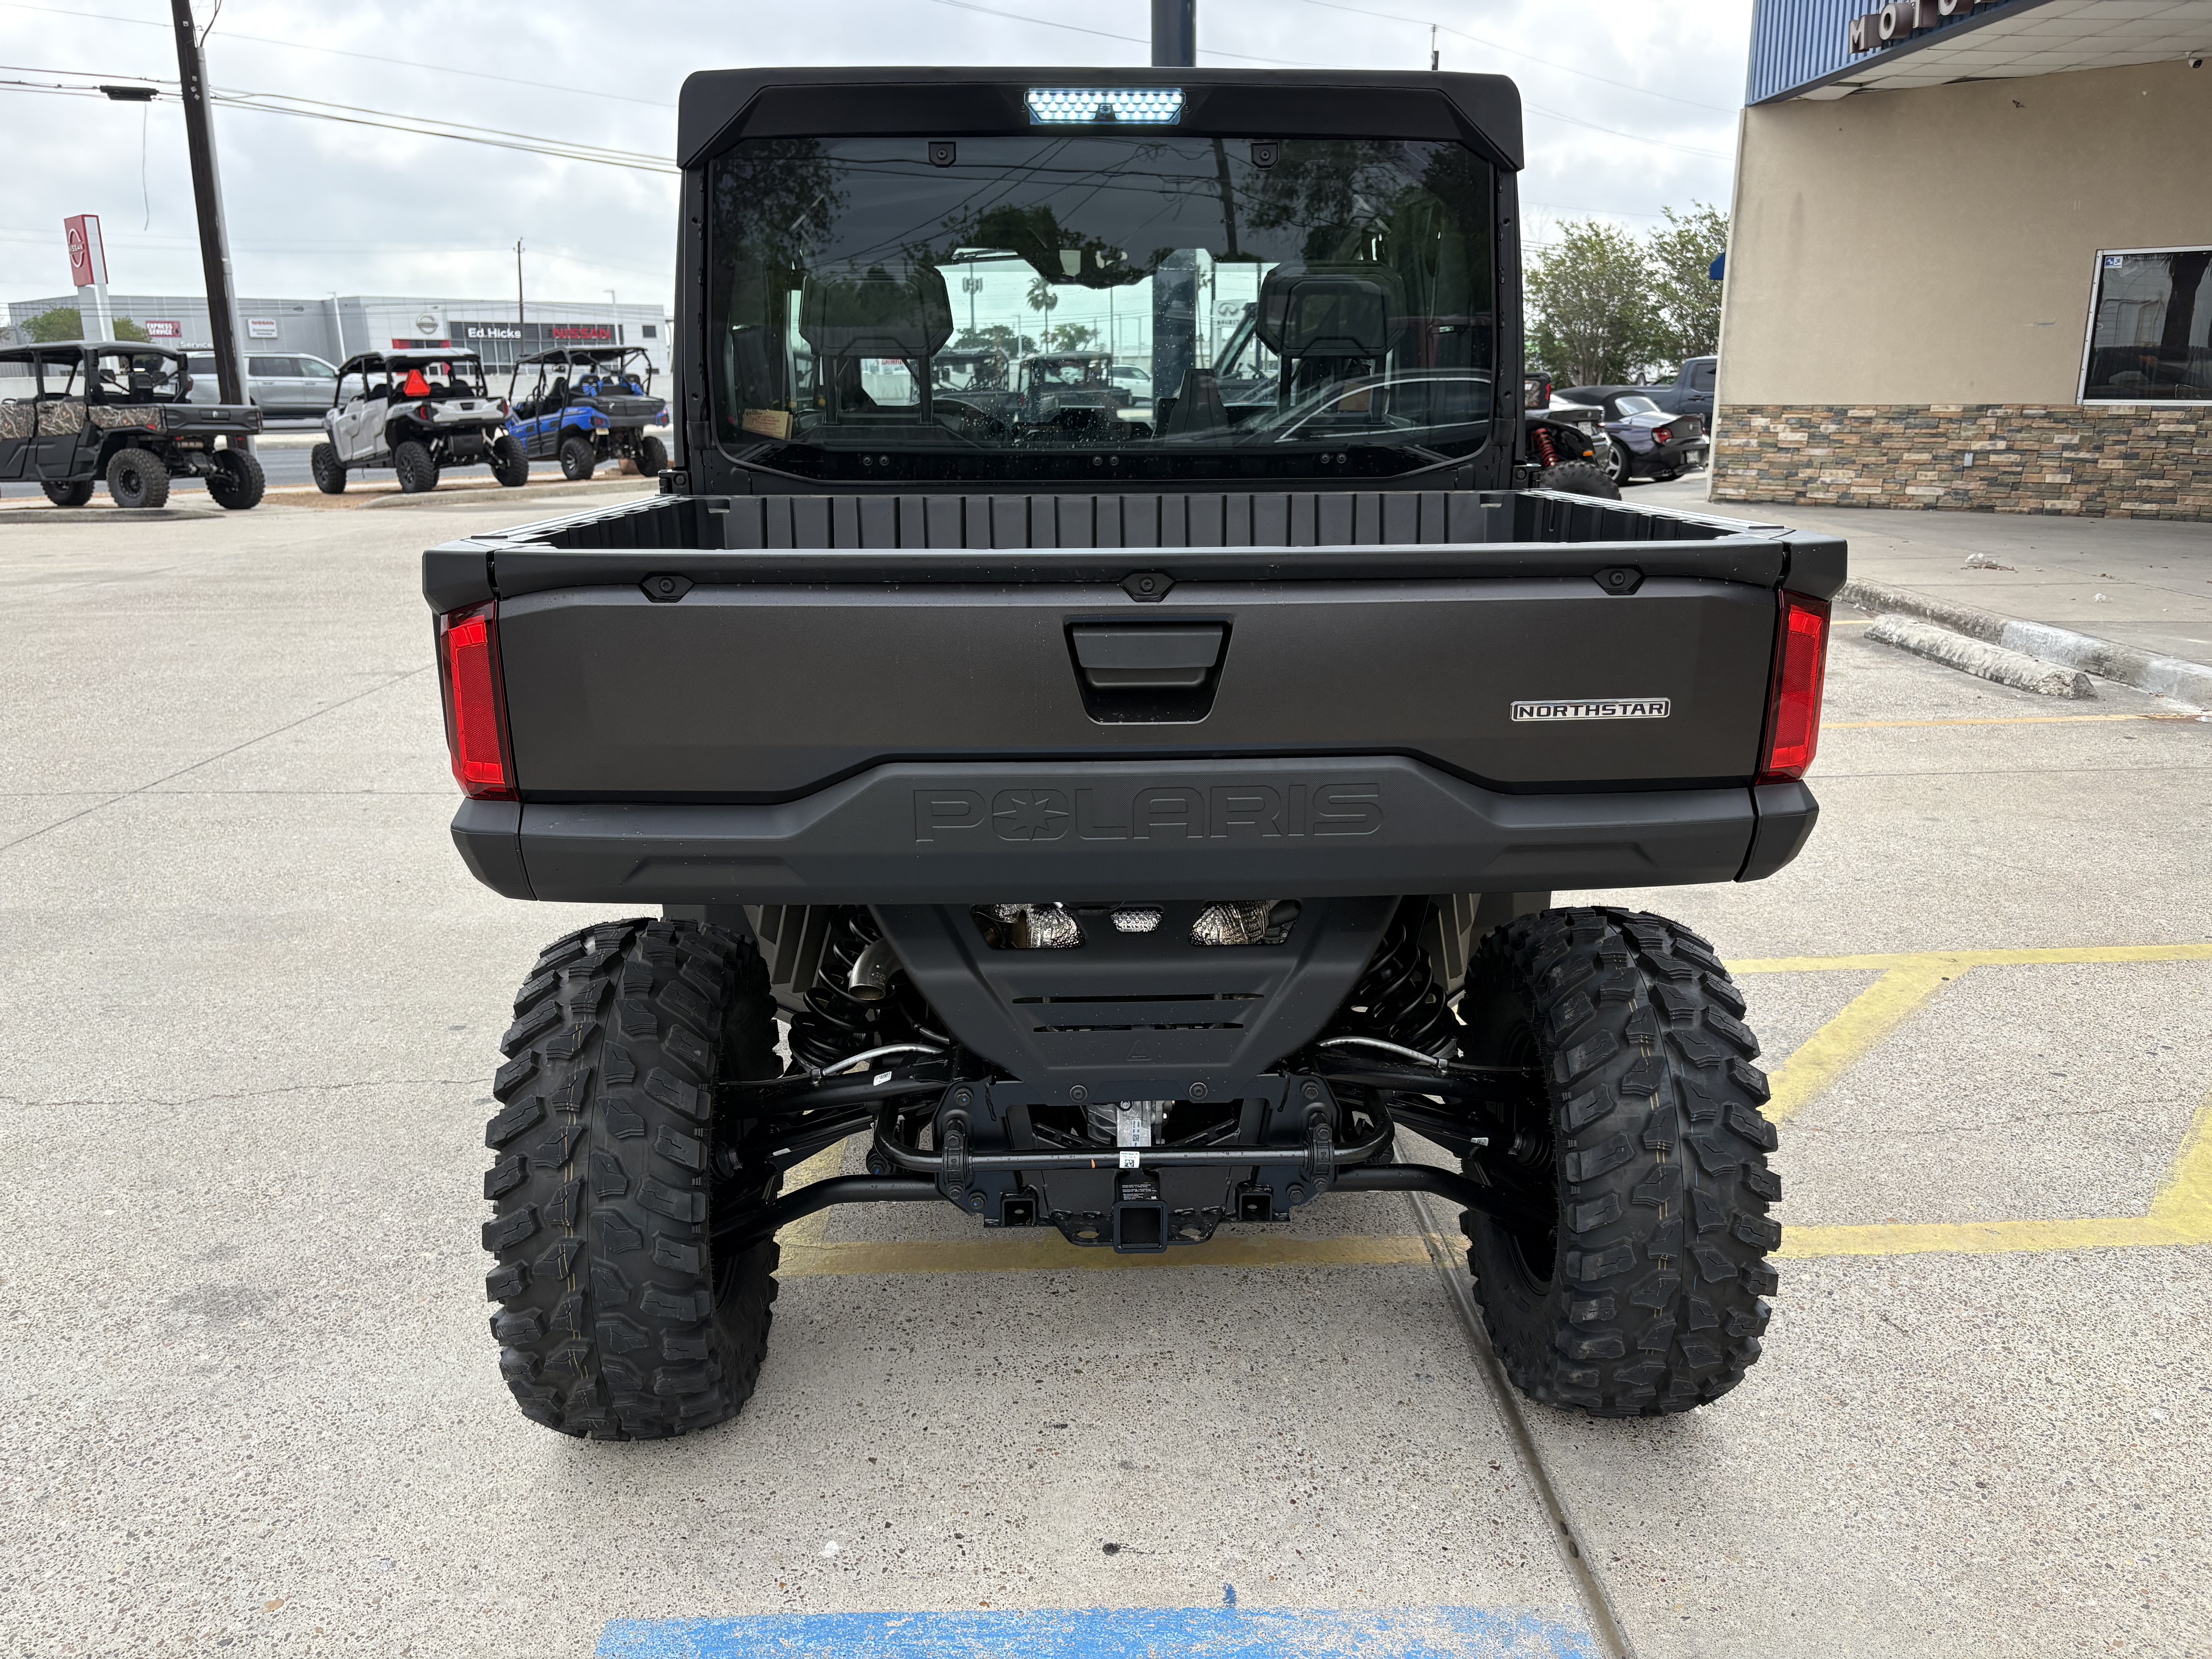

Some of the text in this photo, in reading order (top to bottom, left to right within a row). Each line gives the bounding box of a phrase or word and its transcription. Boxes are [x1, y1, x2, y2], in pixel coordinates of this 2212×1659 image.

[468, 328, 521, 338] Ed Hicks
[553, 328, 611, 339] NISSAN
[1519, 703, 1664, 718] NORTHSTAR
[913, 783, 1383, 843] POLARIS
